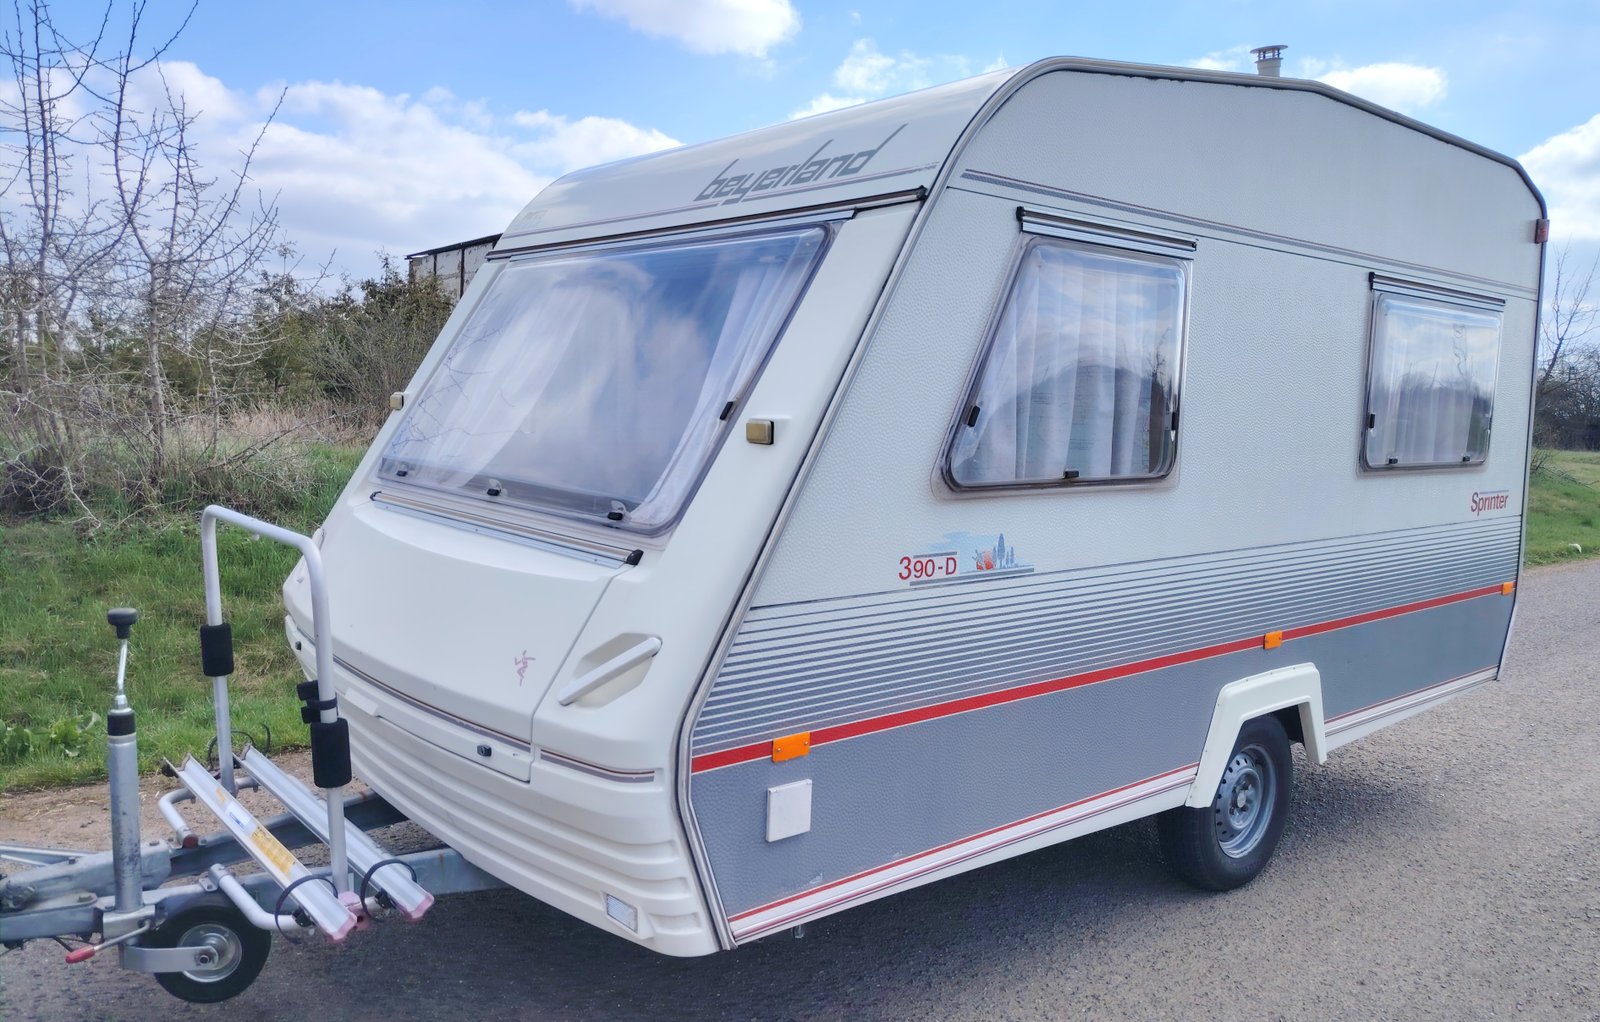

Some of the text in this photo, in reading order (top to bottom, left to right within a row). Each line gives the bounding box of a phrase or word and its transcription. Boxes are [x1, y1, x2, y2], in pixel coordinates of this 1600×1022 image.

[693, 123, 909, 206] beyerland
[1470, 491, 1509, 517] Sprinter
[898, 556, 957, 580] 390-D
